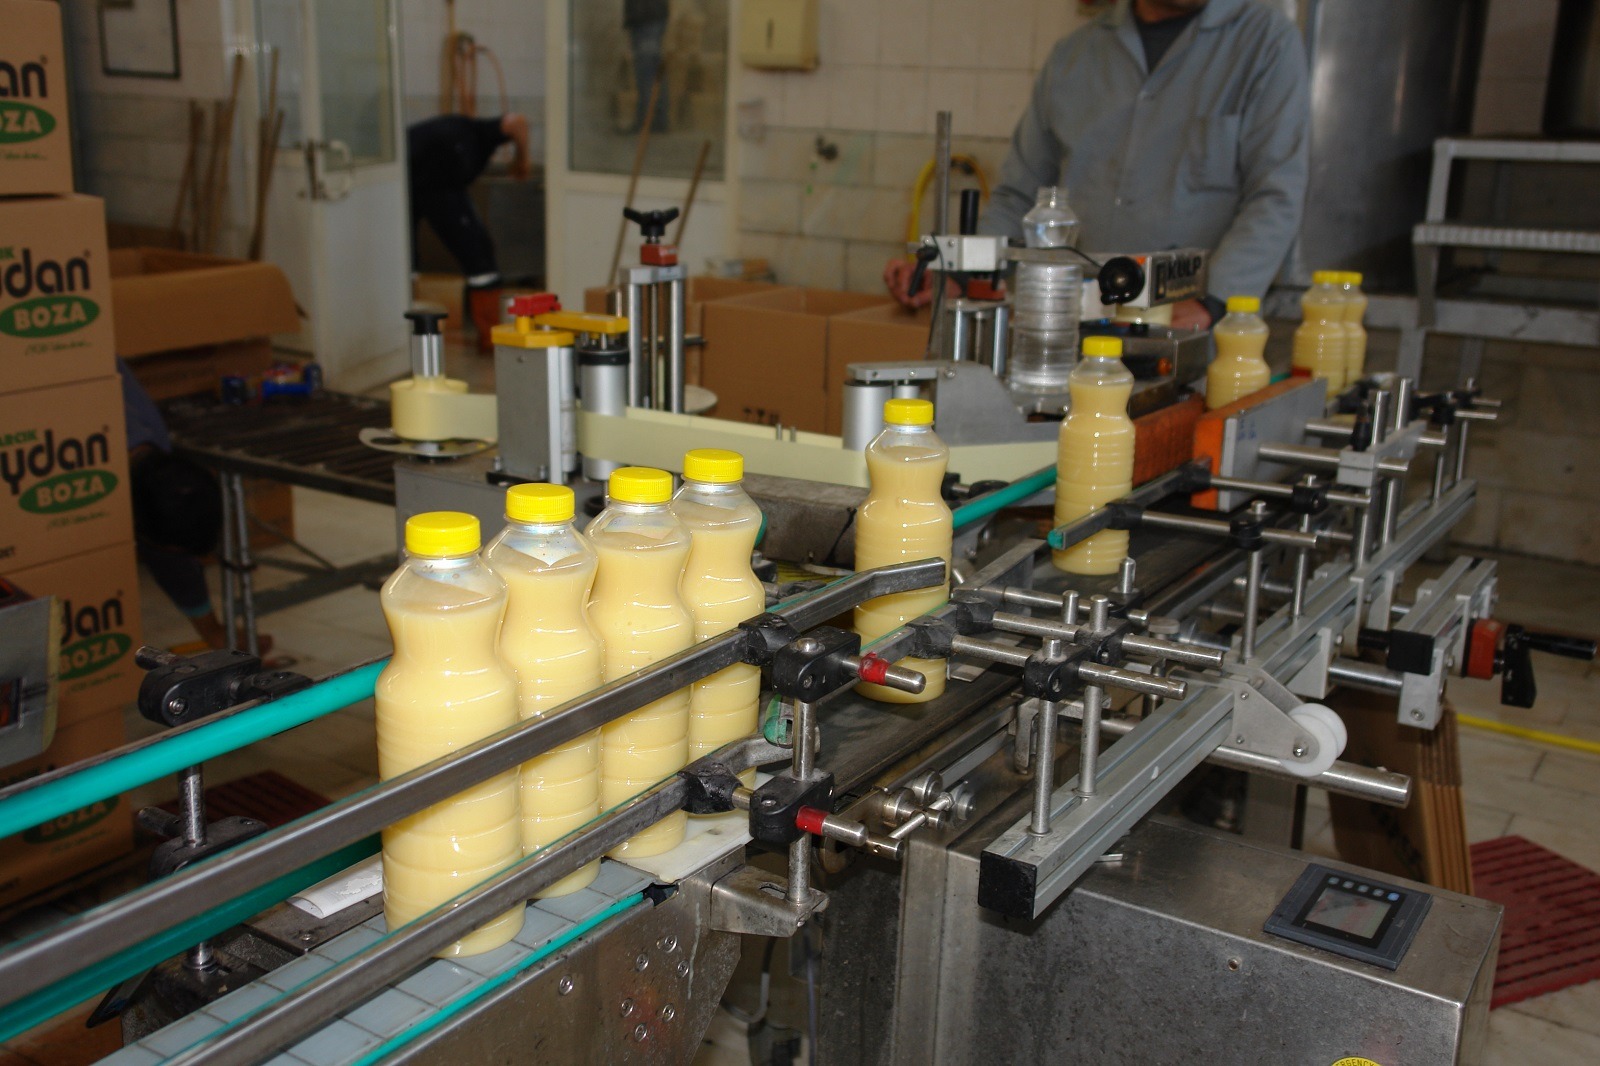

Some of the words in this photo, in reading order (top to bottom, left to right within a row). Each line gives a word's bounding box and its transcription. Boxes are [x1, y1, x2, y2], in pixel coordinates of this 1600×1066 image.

[0, 110, 42, 133] ZA
[0, 248, 90, 298] dan
[13, 301, 87, 330] BOZA
[0, 429, 108, 495] ydan
[36, 475, 105, 507] BOZA
